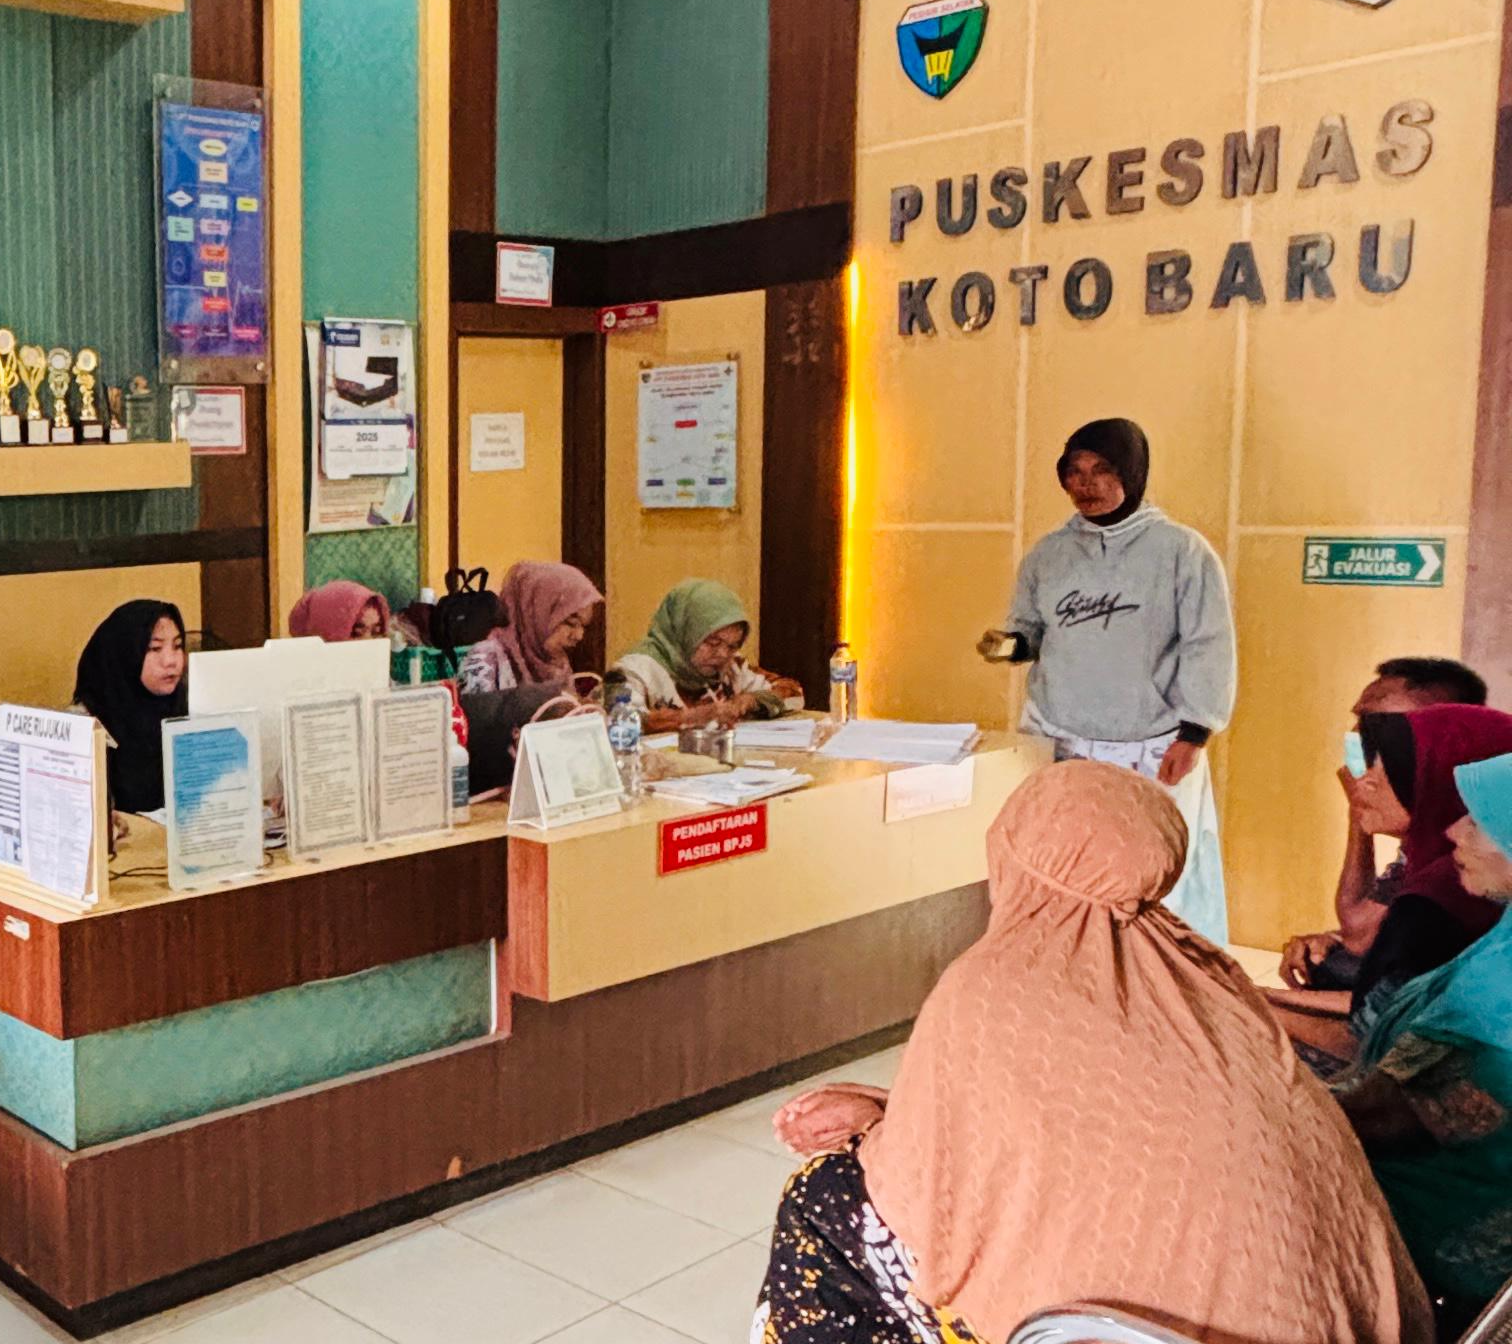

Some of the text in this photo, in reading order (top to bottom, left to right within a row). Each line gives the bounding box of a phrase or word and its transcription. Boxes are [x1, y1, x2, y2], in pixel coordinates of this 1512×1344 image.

[889, 98, 1435, 244] PUSKESMAS
[897, 217, 1415, 337] KOTO BARU
[1333, 561, 1411, 576] EVAKUASI
[1349, 547, 1397, 561] JALUR
[672, 810, 758, 841] PENDAFTARAN
[677, 834, 753, 863] PASIEN BPJS
